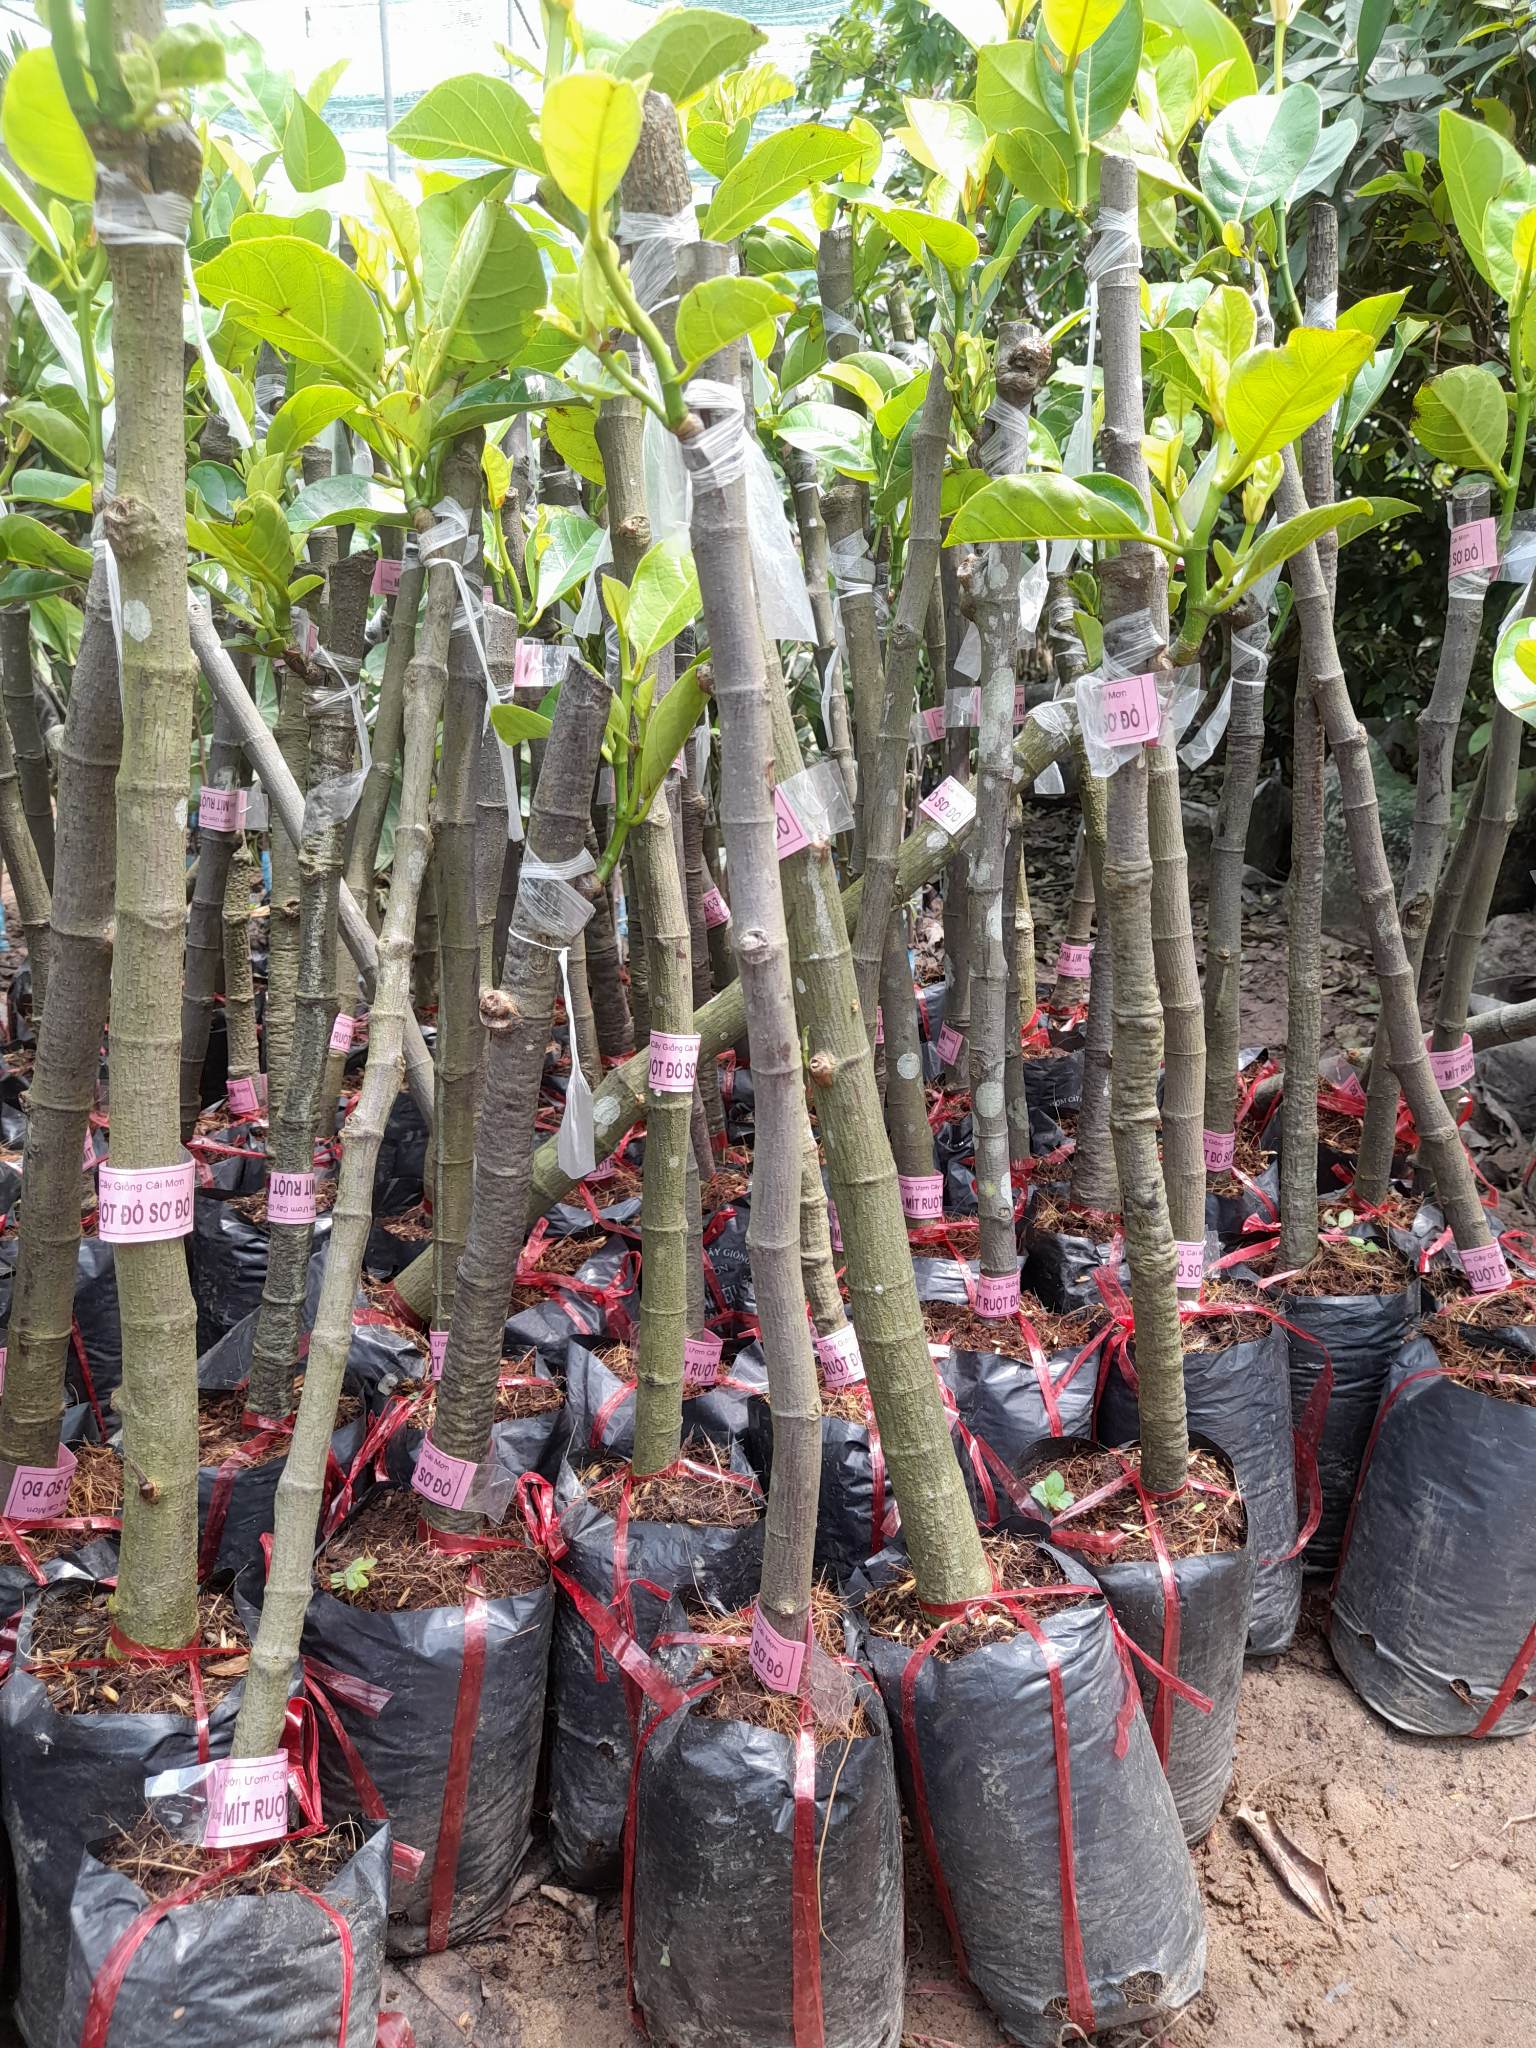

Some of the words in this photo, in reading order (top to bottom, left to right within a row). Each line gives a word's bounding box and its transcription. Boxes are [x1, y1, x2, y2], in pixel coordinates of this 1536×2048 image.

[1452, 552, 1463, 566] SƠ
[1465, 543, 1478, 562] ĐỎ
[1108, 690, 1128, 699] Mơn
[1121, 704, 1140, 730] ĐỎ
[200, 793, 215, 810] RUỘ
[666, 1058, 683, 1079] ĐỎ
[1444, 1065, 1459, 1082] MÍT
[166, 1178, 185, 1188] Mơn
[273, 1176, 301, 1197] RUỘT
[100, 1200, 117, 1229] ỘT
[121, 1199, 144, 1225] ĐỎ
[149, 1201, 172, 1223] SƠ
[175, 1192, 190, 1220] ĐỎ
[905, 1195, 920, 1210] MÍT
[1468, 1265, 1496, 1285] RUỘT
[984, 1296, 1009, 1313] RUỘT
[690, 1361, 717, 1380] RUỘT
[823, 1356, 849, 1376] RUỘT
[22, 1481, 43, 1500] ĐỎ
[44, 1480, 63, 1497] SƠ
[418, 1467, 434, 1486] SƠ
[433, 1478, 451, 1498] ĐỎ
[753, 1640, 767, 1661] SƠ
[766, 1658, 783, 1678] ĐỎ
[245, 1775, 269, 1786] Ươm
[223, 1795, 250, 1827] MÍT
